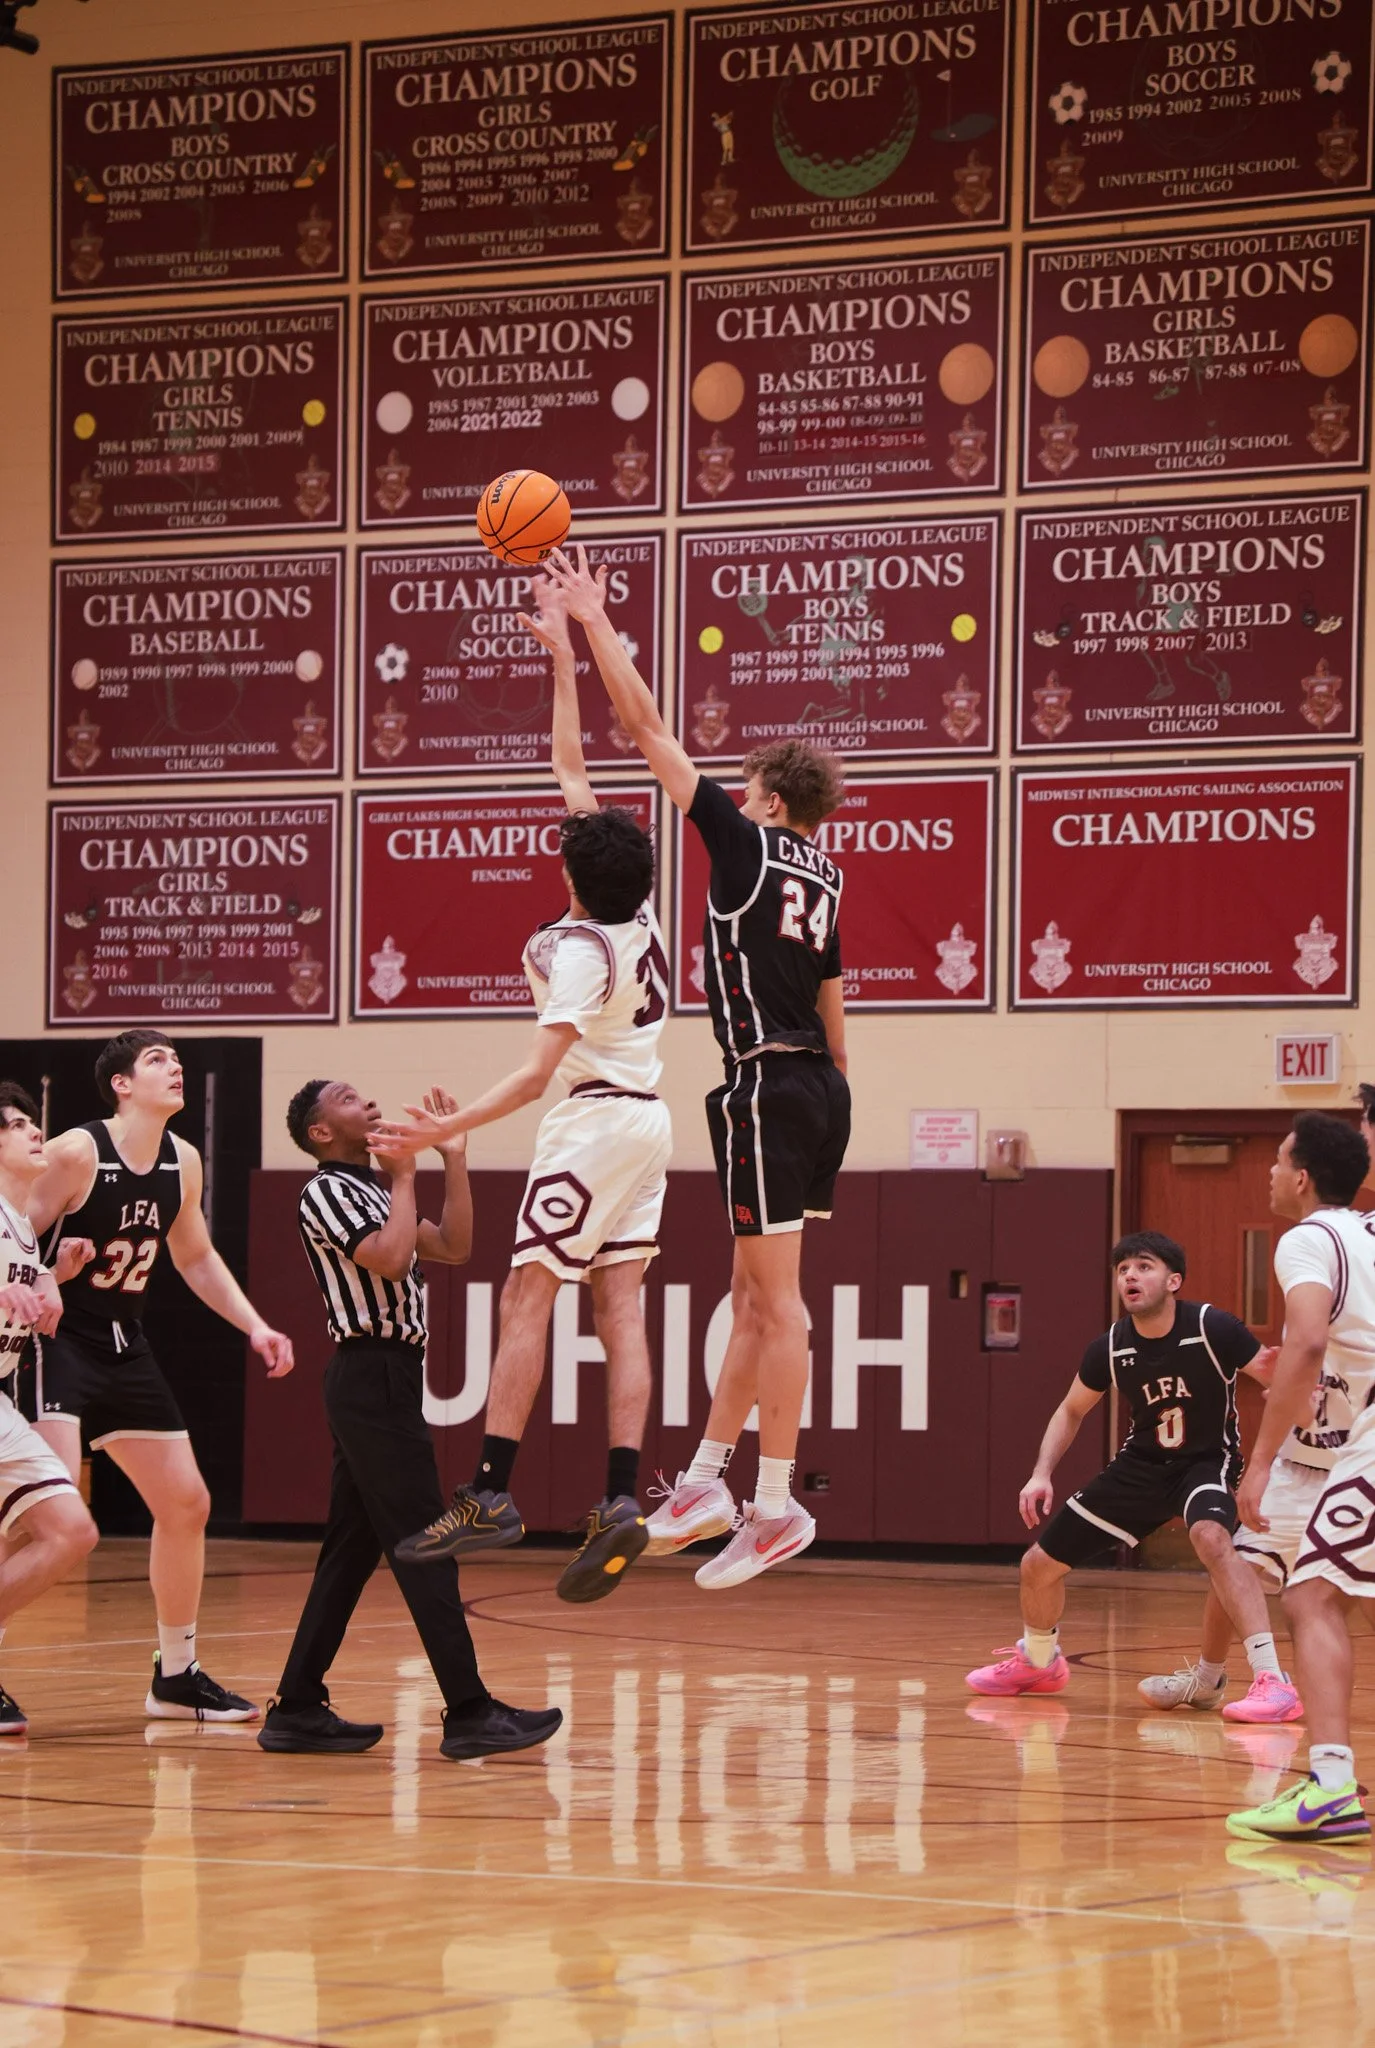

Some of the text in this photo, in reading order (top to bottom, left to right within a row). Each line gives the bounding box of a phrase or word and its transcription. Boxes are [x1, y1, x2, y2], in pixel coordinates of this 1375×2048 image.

[701, 0, 1000, 40] INDEPENDENT SCHOOL LEAGUE
[1067, 0, 1343, 47] CHAMPIONS
[377, 28, 658, 70] INDEPENDENT SCHOOL LEAGUE
[720, 24, 977, 82] CHAMPIONS
[1167, 39, 1237, 68] BOYS
[67, 60, 336, 96] INDEPENDENT SCHOOL LEAGUE
[395, 53, 638, 108] CHAMPIONS
[810, 75, 883, 102] GOLF
[1145, 65, 1256, 98] SOCCER
[85, 84, 317, 134] CHAMPIONS
[478, 101, 552, 129] GIRLS
[171, 133, 230, 157] BOYS
[413, 120, 617, 159] CROSS COUNTRY
[103, 153, 297, 187] CROSS COUNTRY
[1099, 157, 1300, 188] UNIVERSITY HIGH SCHOOL
[1163, 181, 1233, 198] CHICAGO
[751, 192, 939, 219] UNIVERSITY HIGH SCHOOL
[810, 214, 876, 229] CHICAGO
[1040, 230, 1359, 272] INDEPENDENT SCHOOL LEAGUE
[697, 262, 995, 300] INDEPENDENT SCHOOL LEAGUE
[1060, 256, 1334, 313] CHAMPIONS
[375, 289, 655, 322] INDEPENDENT SCHOOL LEAGUE
[716, 289, 971, 342] CHAMPIONS
[67, 315, 334, 347] INDEPENDENT SCHOOL LEAGUE
[1153, 306, 1236, 334] GIRLS
[393, 316, 634, 364] CHAMPIONS
[809, 339, 875, 364] BOYS
[1105, 330, 1285, 364] BASKETBALL
[84, 341, 314, 387] CHAMPIONS
[432, 360, 592, 389] VOLLEYBALL
[1092, 358, 1300, 388] 84-85 86-87 87-88 07-08
[757, 363, 927, 395] BASKETBALL
[163, 384, 233, 409] GIRLS
[757, 392, 923, 416] 84-85 90-91
[153, 407, 243, 432] TENNIS
[460, 410, 542, 433] 2021 2022
[801, 416, 845, 431] 99-00
[1092, 435, 1292, 459] UNIVERSITY HIGH SCHOOL
[136, 455, 214, 475] 2014 2015
[747, 459, 933, 483] UNIVERSITY HIGH SCHOOL
[1155, 454, 1225, 470] CHICAGO
[806, 478, 871, 493] CHICAGO
[1032, 506, 1350, 540] INDEPENDENT SCHOOL LEAGUE
[692, 525, 987, 557] INDEPENDENT SCHOOL LEAGUE
[372, 556, 499, 575] INDEPENDENT
[1052, 534, 1326, 583] CHAMPIONS
[66, 560, 332, 587] INDEPENDENT SCHOOL LEAGUE
[711, 553, 965, 598] CHAMPIONS
[83, 585, 313, 627] CHAMPIONS
[389, 570, 629, 614] CHAMPS
[1152, 581, 1222, 605] BOYS
[804, 596, 868, 620] BOYS
[1080, 603, 1291, 635] TRACK & FIELD
[129, 628, 265, 656] BASEBALL
[786, 620, 885, 645] TENNIS
[1073, 631, 1247, 655] 1997 1998 2007 2013
[1085, 701, 1285, 722] UNIVERSITY HIGH SCHOOL
[742, 718, 927, 737] UNIVERSITY HIGH SCHOOL
[1149, 719, 1218, 733] CHICAGO
[419, 735, 500, 749] UNIVERSITY
[1028, 780, 1344, 801] MIDWEST INTERSCHOLASTIC SAILING ASSOCIATION
[63, 809, 328, 831] INDEPENDENT SCHOOL LEAGUE
[369, 808, 518, 823] GREAT LAKES HIGH SCHOOL
[1052, 806, 1316, 847] CHAMPIONS
[387, 824, 562, 860] CHAMPIO
[806, 818, 954, 853] MPIONS
[80, 833, 309, 871] CHAMPIONS
[778, 835, 836, 883] CAXYS
[158, 872, 228, 893] GIRLS
[472, 869, 532, 883] FENCING
[105, 894, 281, 917] TRACK & FIELD
[778, 876, 829, 955] 24
[218, 941, 299, 957] 2014 2015
[93, 964, 127, 979] 2016
[417, 975, 529, 989] UNIVERSITY HIGH
[861, 968, 917, 980] SCHOOL
[1085, 961, 1272, 977] UNIVERSITY HIGH SCHOOL
[224, 982, 275, 994] SCHOOL
[470, 988, 531, 1002] CHICAGO
[1144, 978, 1211, 991] CHICAGO
[162, 997, 221, 1010] CHICAGO
[1282, 1042, 1328, 1078] EXIT
[119, 1200, 160, 1231] LFA
[90, 1237, 159, 1293] 32
[1142, 1377, 1192, 1405] LFA
[1155, 1406, 1184, 1448] 0
